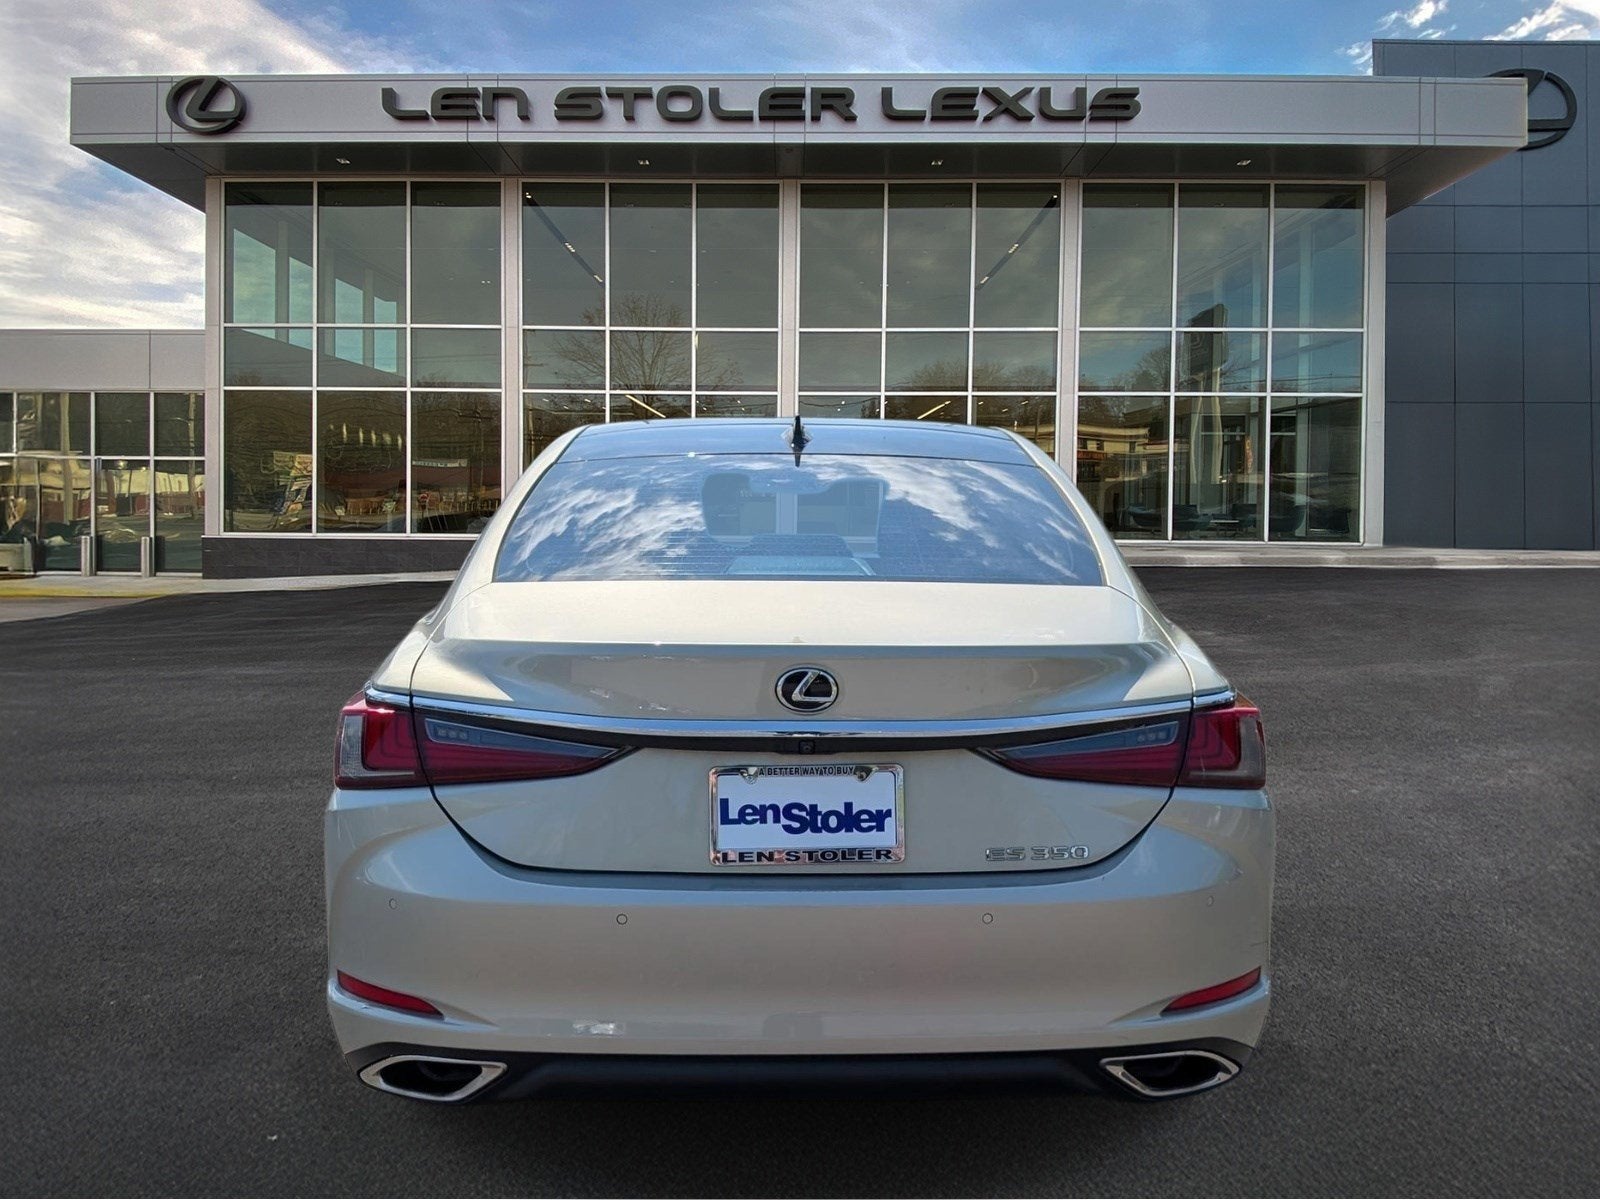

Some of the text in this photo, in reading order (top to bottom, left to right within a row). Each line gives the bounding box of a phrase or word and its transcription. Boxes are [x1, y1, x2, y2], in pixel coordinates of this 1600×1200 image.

[381, 84, 1142, 122] LEN STOLER LEXUS
[758, 765, 855, 776] A BETTER WAY TO BUY
[721, 849, 894, 864] LEN STOLER
[985, 845, 1090, 861] ES 350
